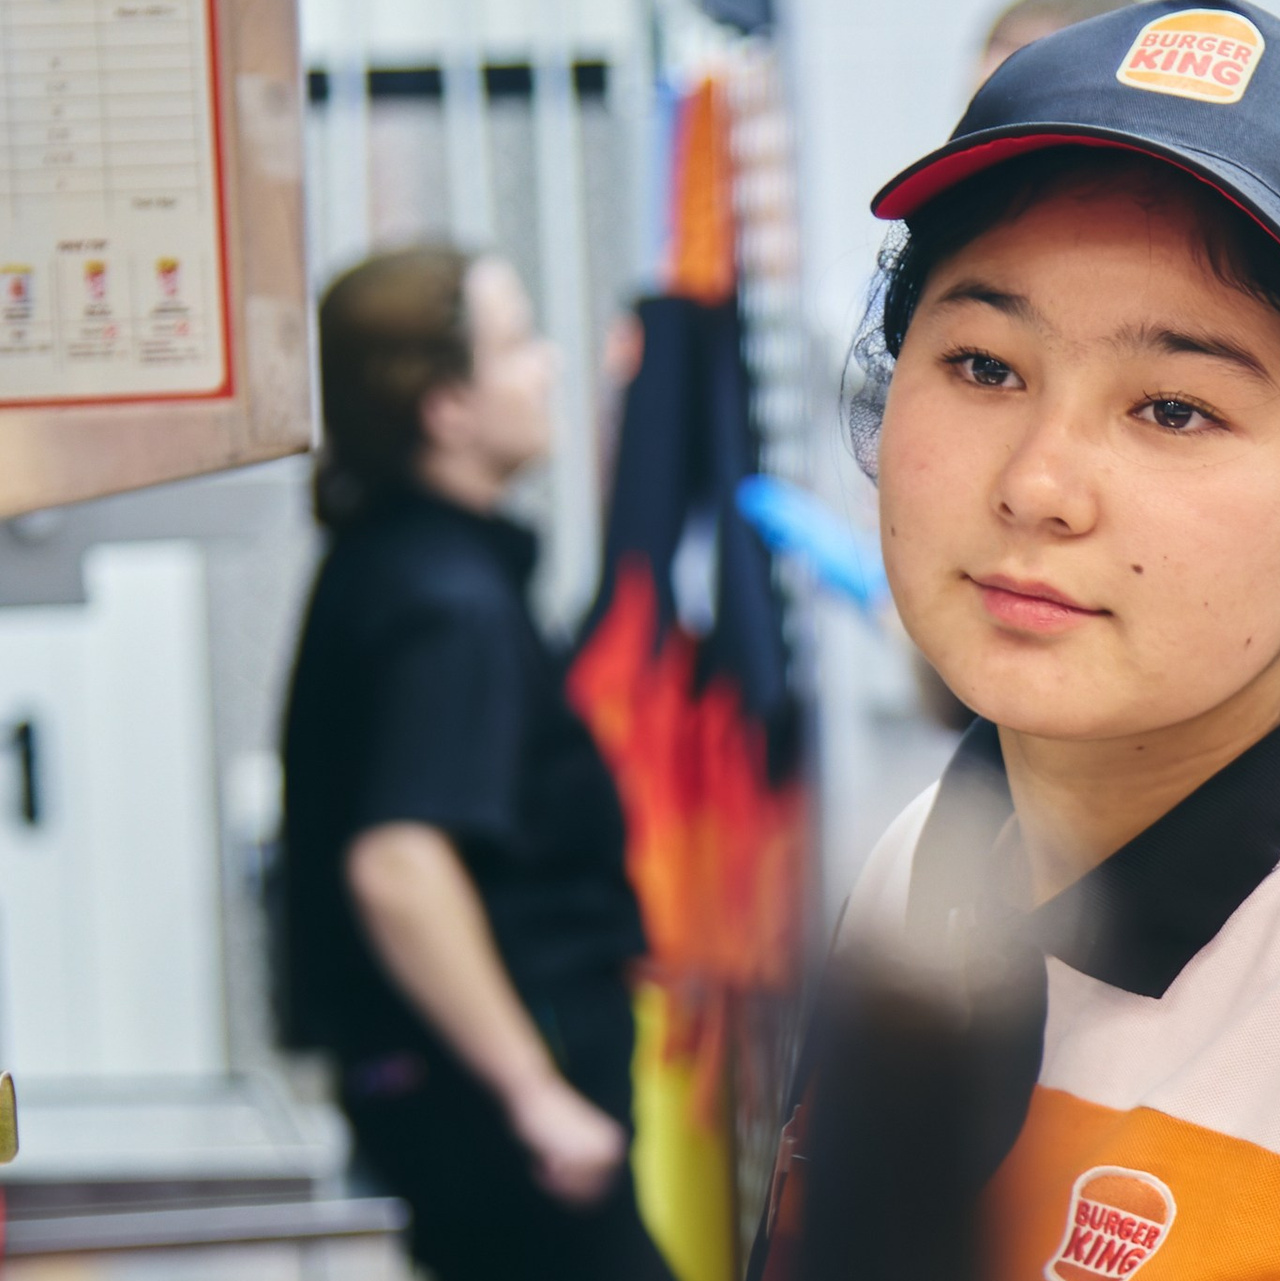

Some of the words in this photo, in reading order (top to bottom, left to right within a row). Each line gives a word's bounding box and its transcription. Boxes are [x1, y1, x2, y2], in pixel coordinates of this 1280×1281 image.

[1129, 48, 1244, 86] KING
[1140, 33, 1253, 65] BURGER
[1075, 1199, 1161, 1250] BURGER
[1062, 1226, 1146, 1276] KING
